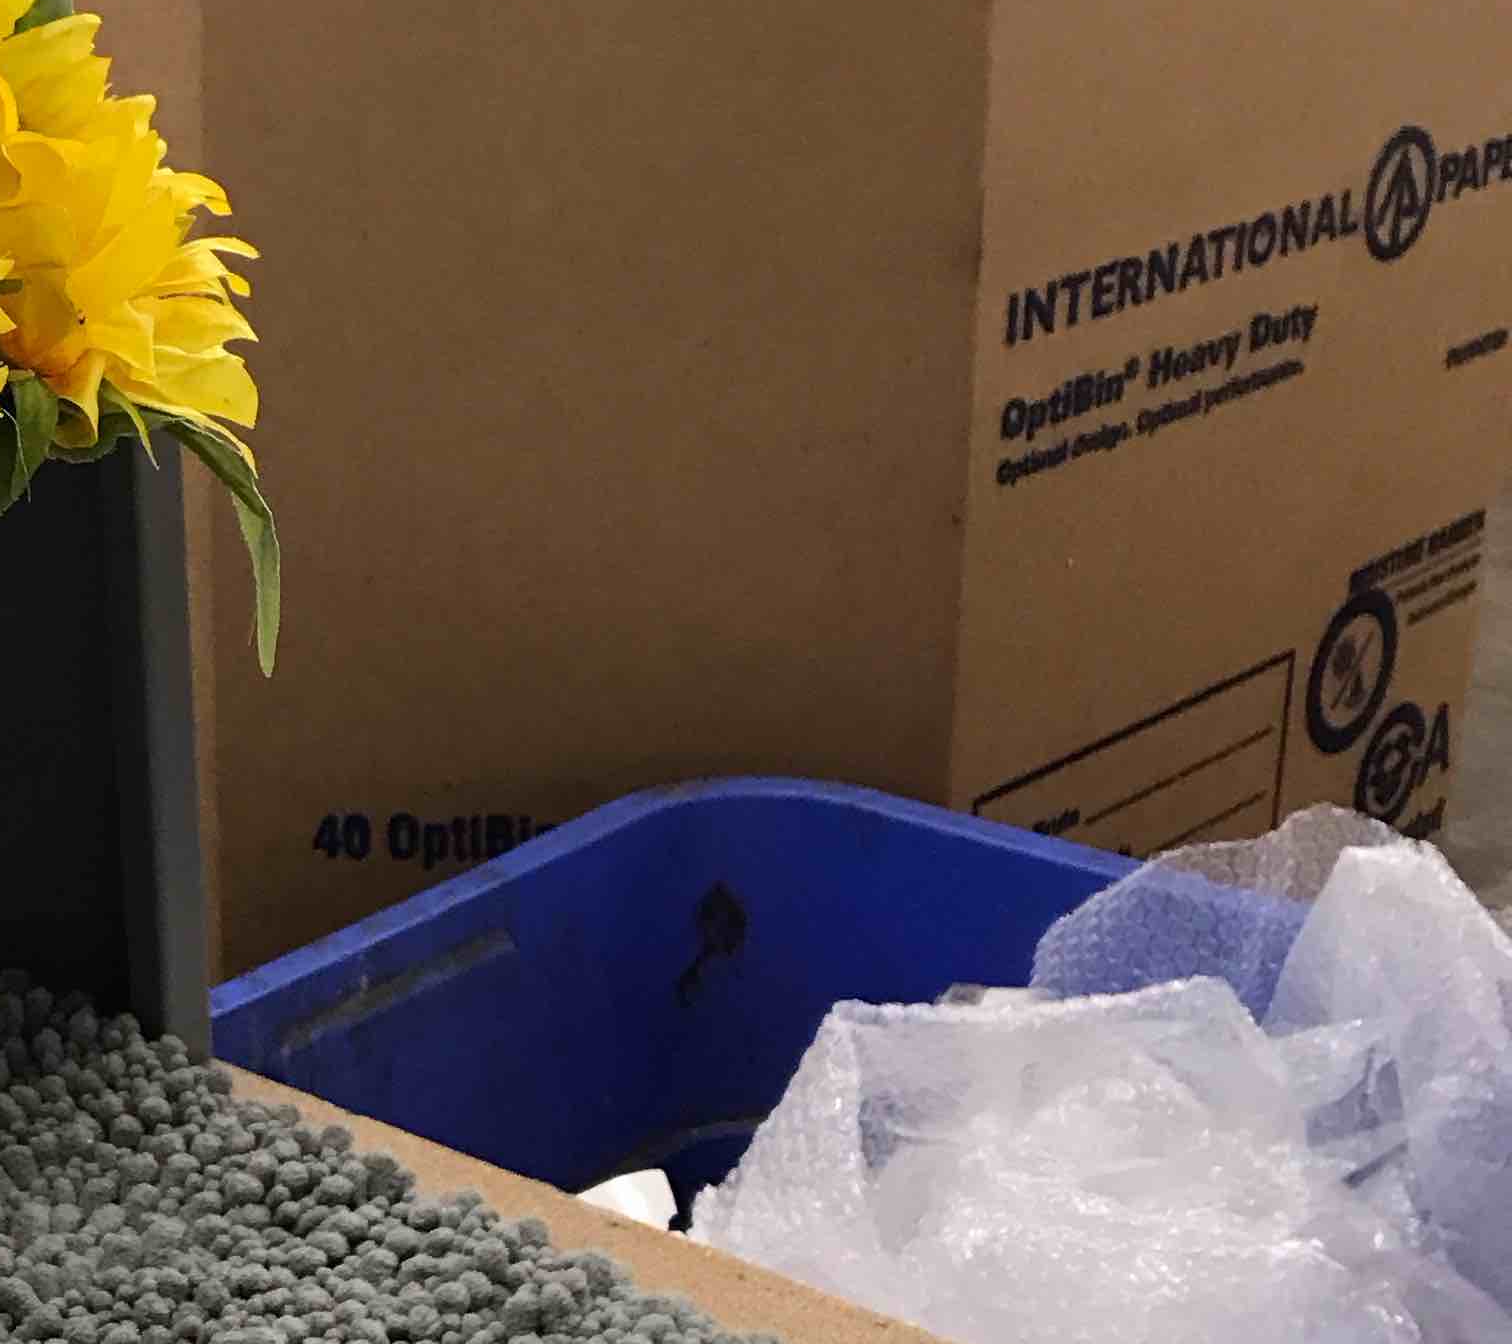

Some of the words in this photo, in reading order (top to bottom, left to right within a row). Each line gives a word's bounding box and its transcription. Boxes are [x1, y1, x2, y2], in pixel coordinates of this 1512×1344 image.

[1003, 188, 1360, 348] INTERNATIONAL
[1146, 331, 1243, 390] Heavy
[1249, 301, 1320, 353] Duty
[312, 812, 372, 859] 40
